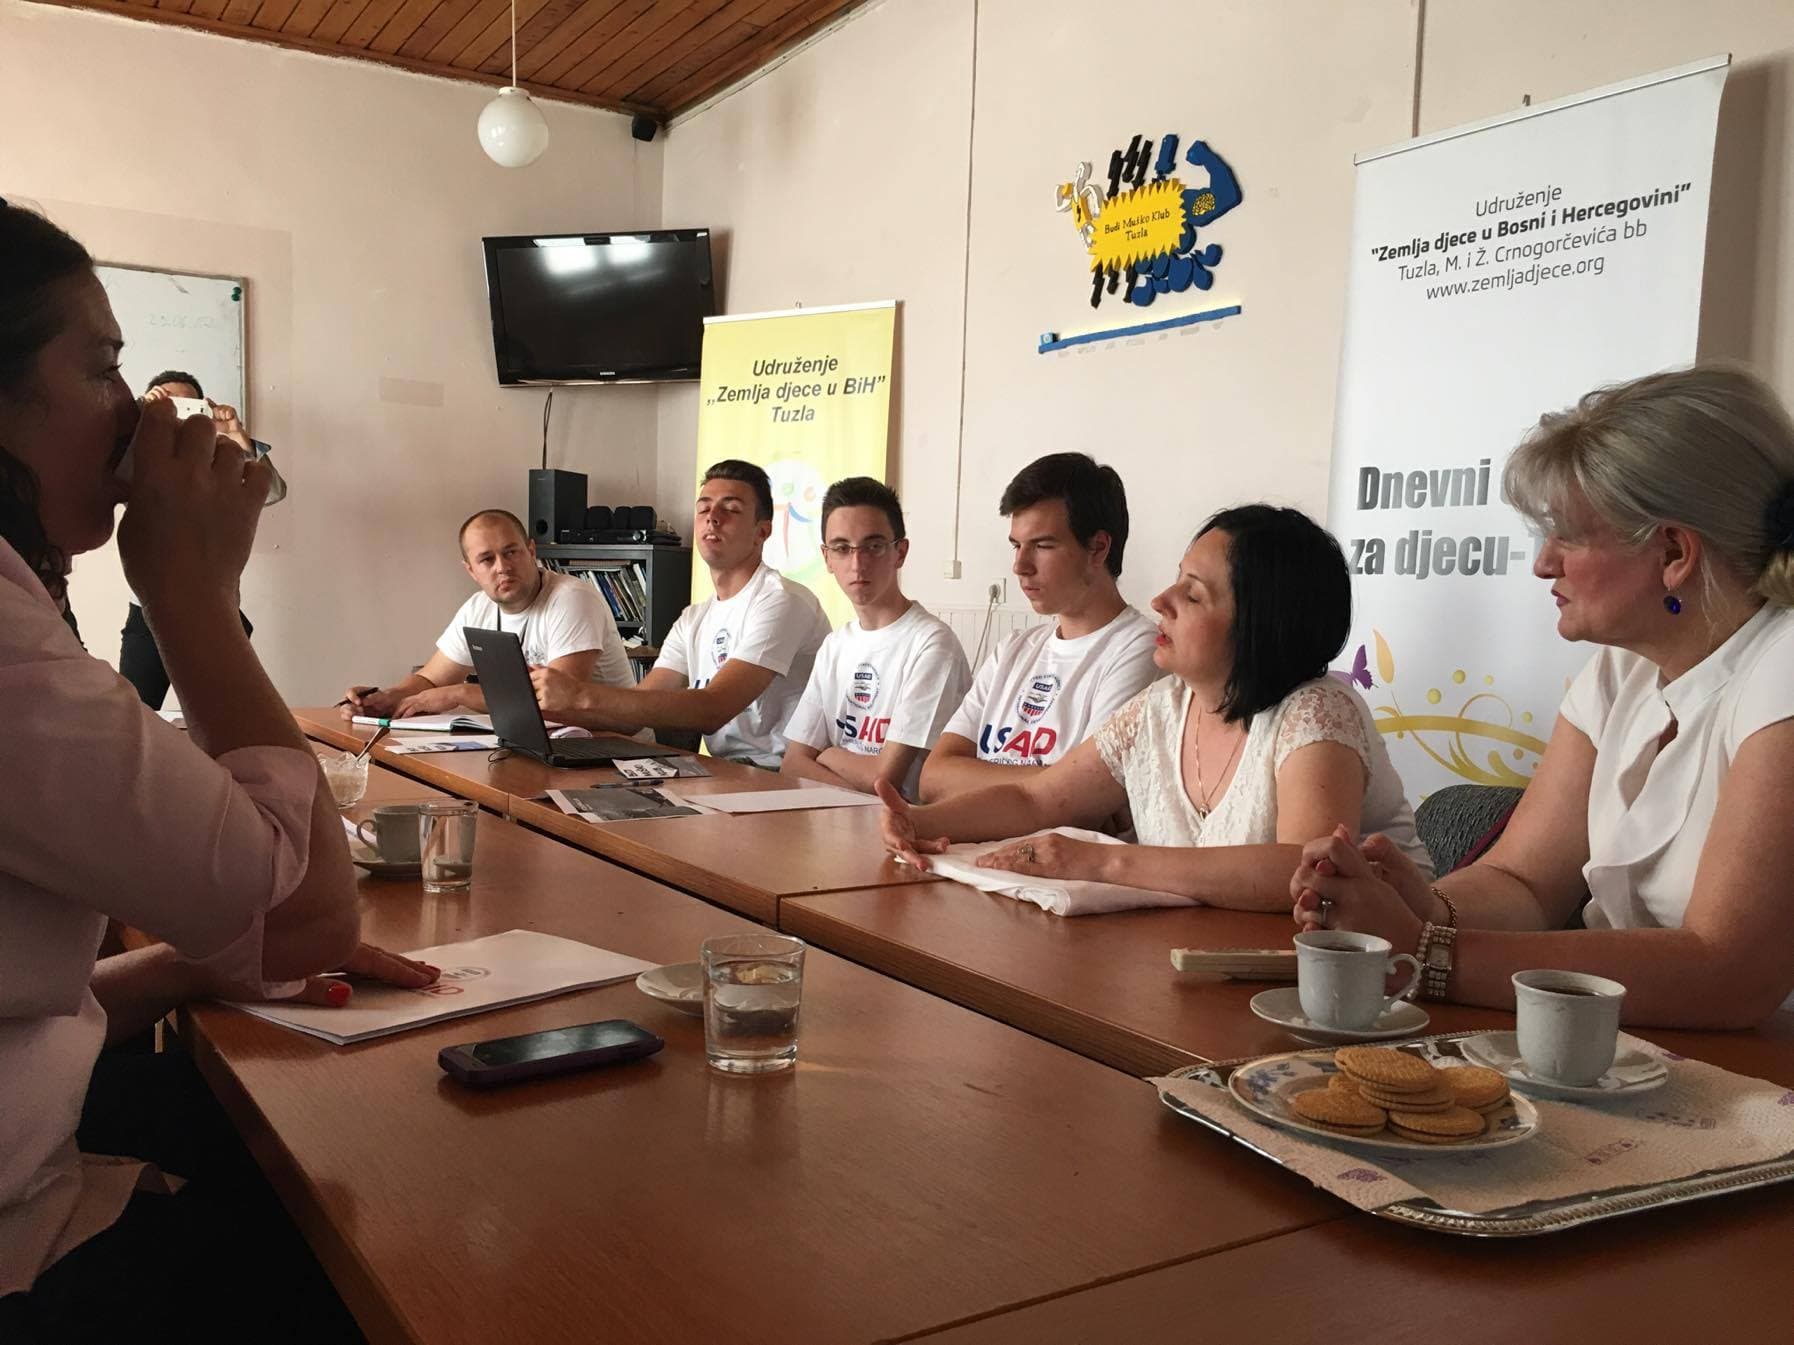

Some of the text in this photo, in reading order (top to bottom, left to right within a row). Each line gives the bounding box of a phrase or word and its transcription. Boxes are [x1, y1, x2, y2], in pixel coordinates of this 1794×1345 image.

[1152, 208, 1170, 222] Klub
[1475, 185, 1563, 217] Udruženje
[1125, 227, 1148, 241] Tuzla
[1434, 229, 1477, 254] djece
[1481, 227, 1492, 241] u
[1497, 215, 1546, 238] Bosni
[1550, 209, 1557, 227] i
[1398, 218, 1647, 281] Tuzla, M. i Ž. Crnogorčevića bb
[1426, 255, 1605, 300] www.zemljadjece.org
[752, 355, 838, 377] Udruženje
[775, 382, 822, 403] djece
[827, 383, 837, 396] u
[771, 405, 816, 423] Tuzla
[1357, 458, 1492, 511] Dnevni
[1350, 537, 1386, 576] za
[1394, 529, 1526, 580] djecu-
